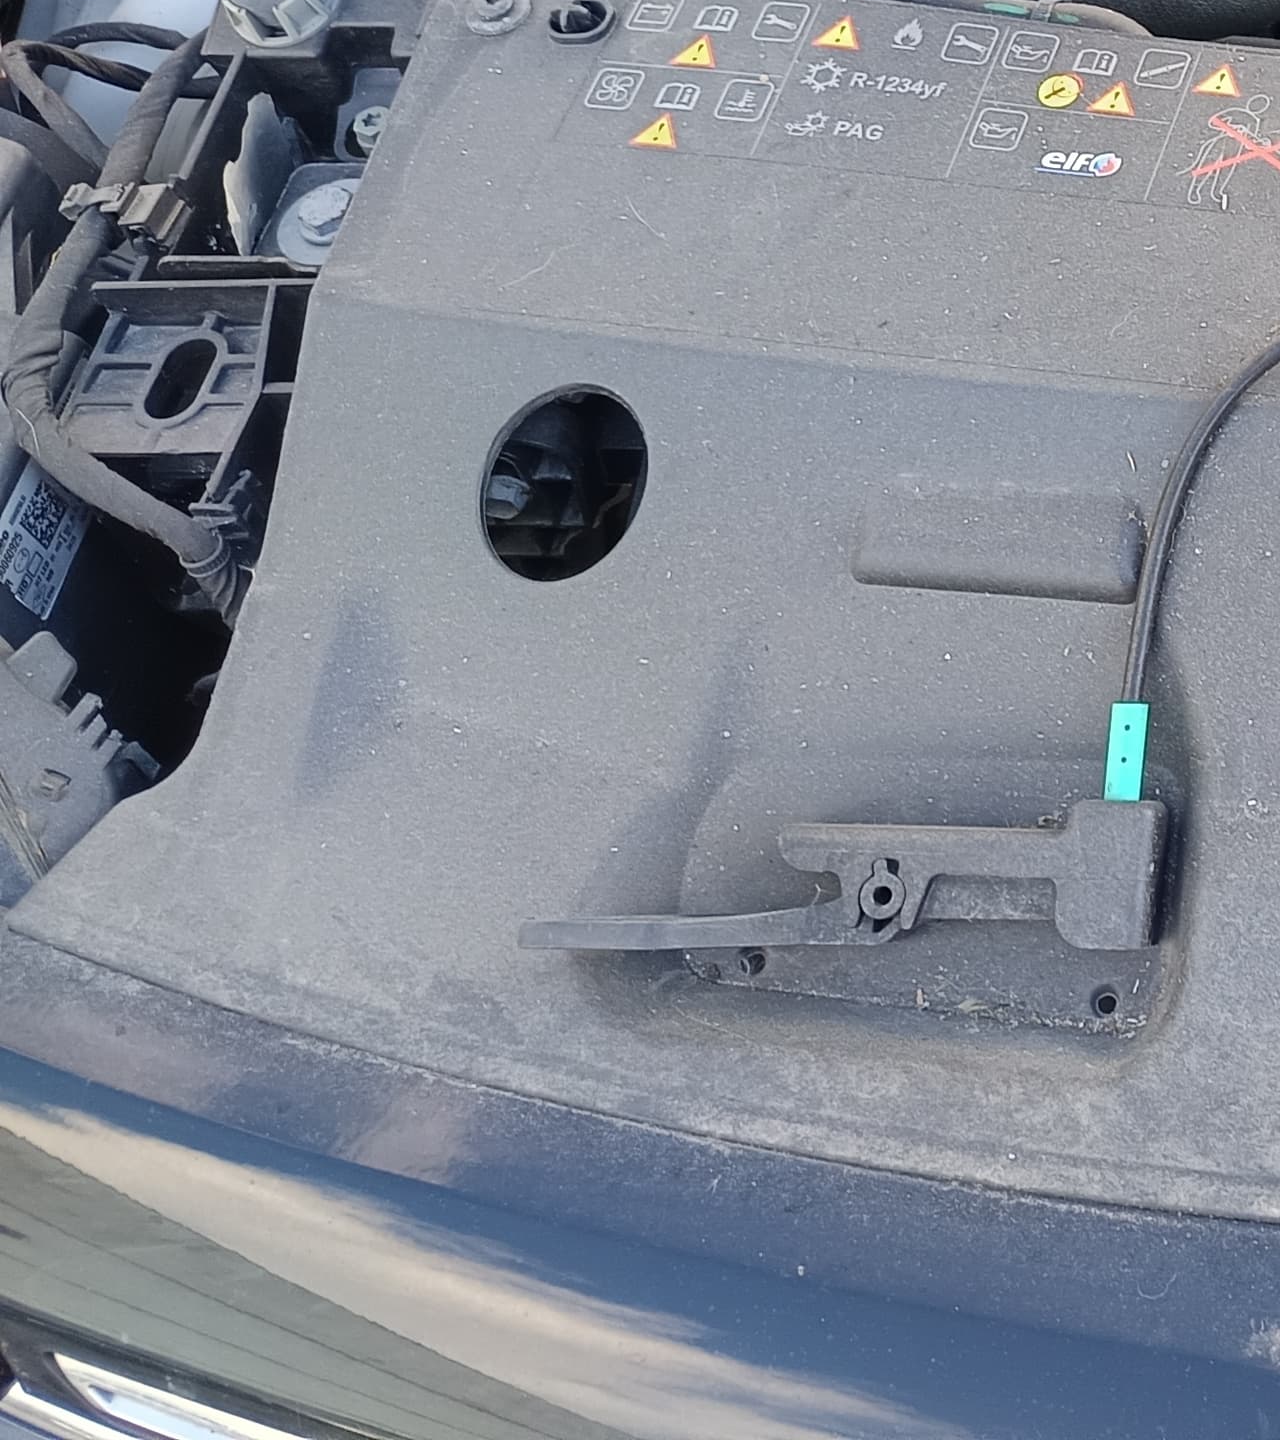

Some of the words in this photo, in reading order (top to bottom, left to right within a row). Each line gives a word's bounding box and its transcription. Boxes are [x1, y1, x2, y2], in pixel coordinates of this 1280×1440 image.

[849, 71, 948, 99] R-1234yf
[833, 120, 884, 140] PAG
[1041, 151, 1096, 172] elf
